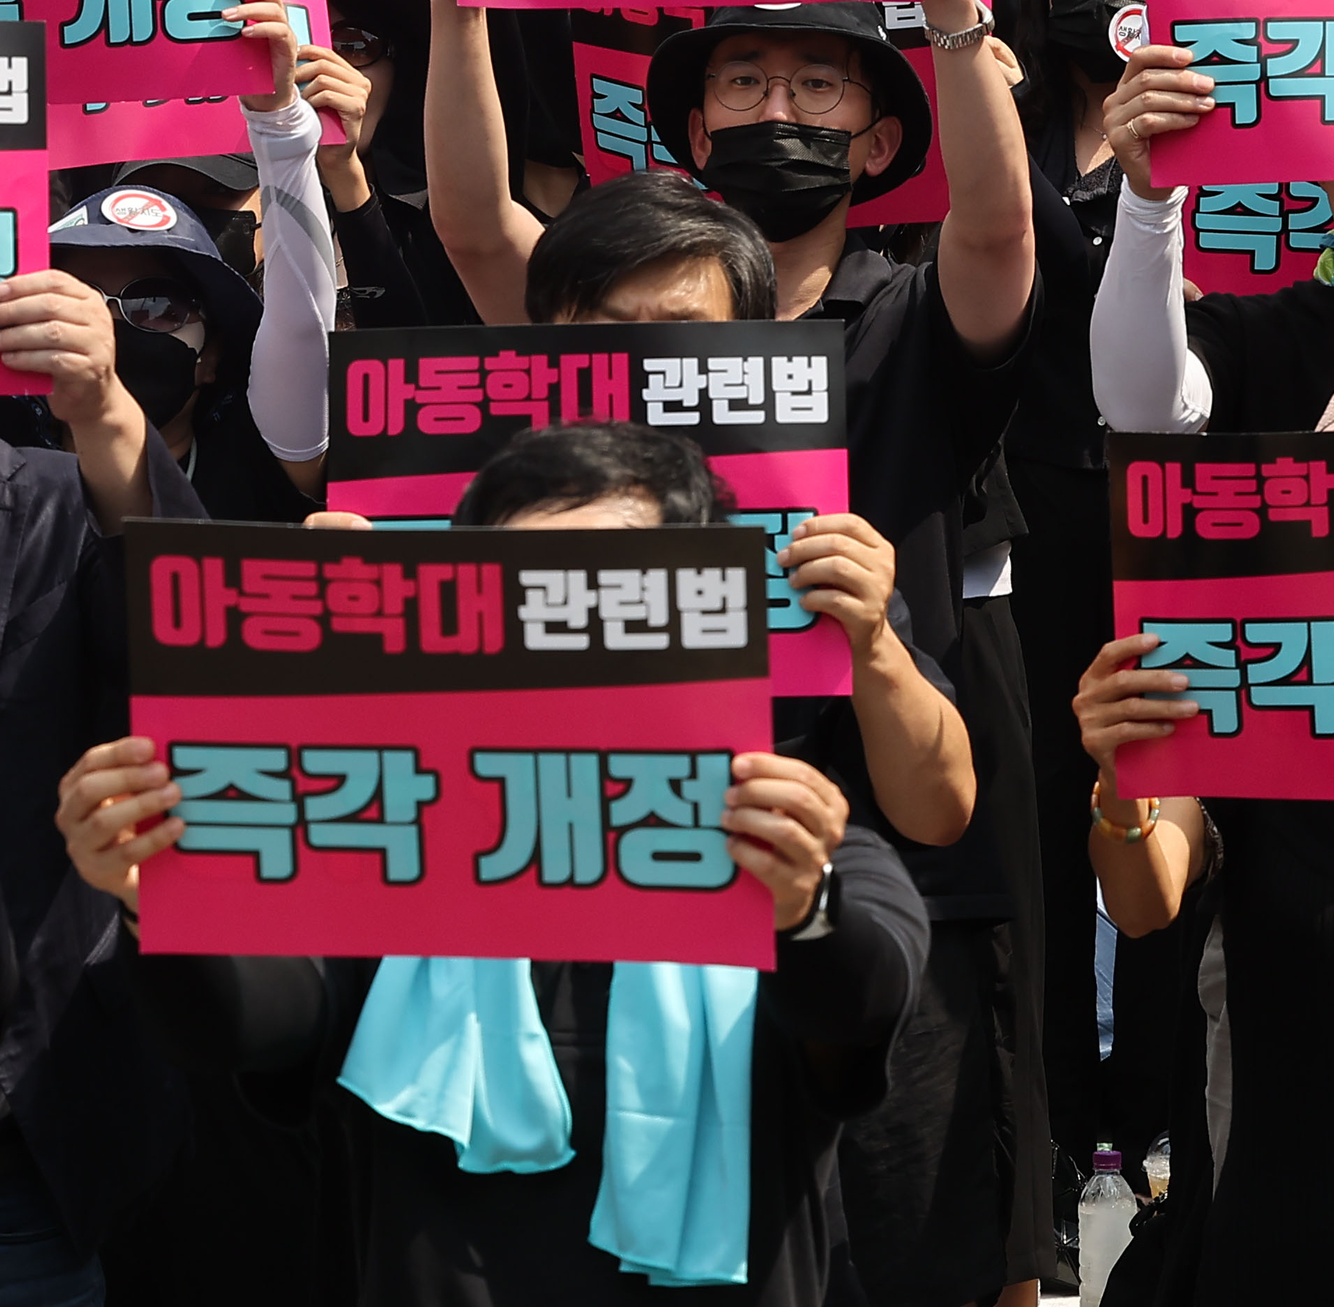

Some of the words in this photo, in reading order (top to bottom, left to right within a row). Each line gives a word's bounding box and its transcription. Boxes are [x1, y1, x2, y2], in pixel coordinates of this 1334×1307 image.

[345, 350, 631, 437] 아동학대
[641, 355, 830, 427] 관련법
[149, 555, 505, 655] 아동학대
[516, 567, 749, 652] 관련법
[167, 742, 441, 885] 즉각
[470, 748, 738, 889] 개정
